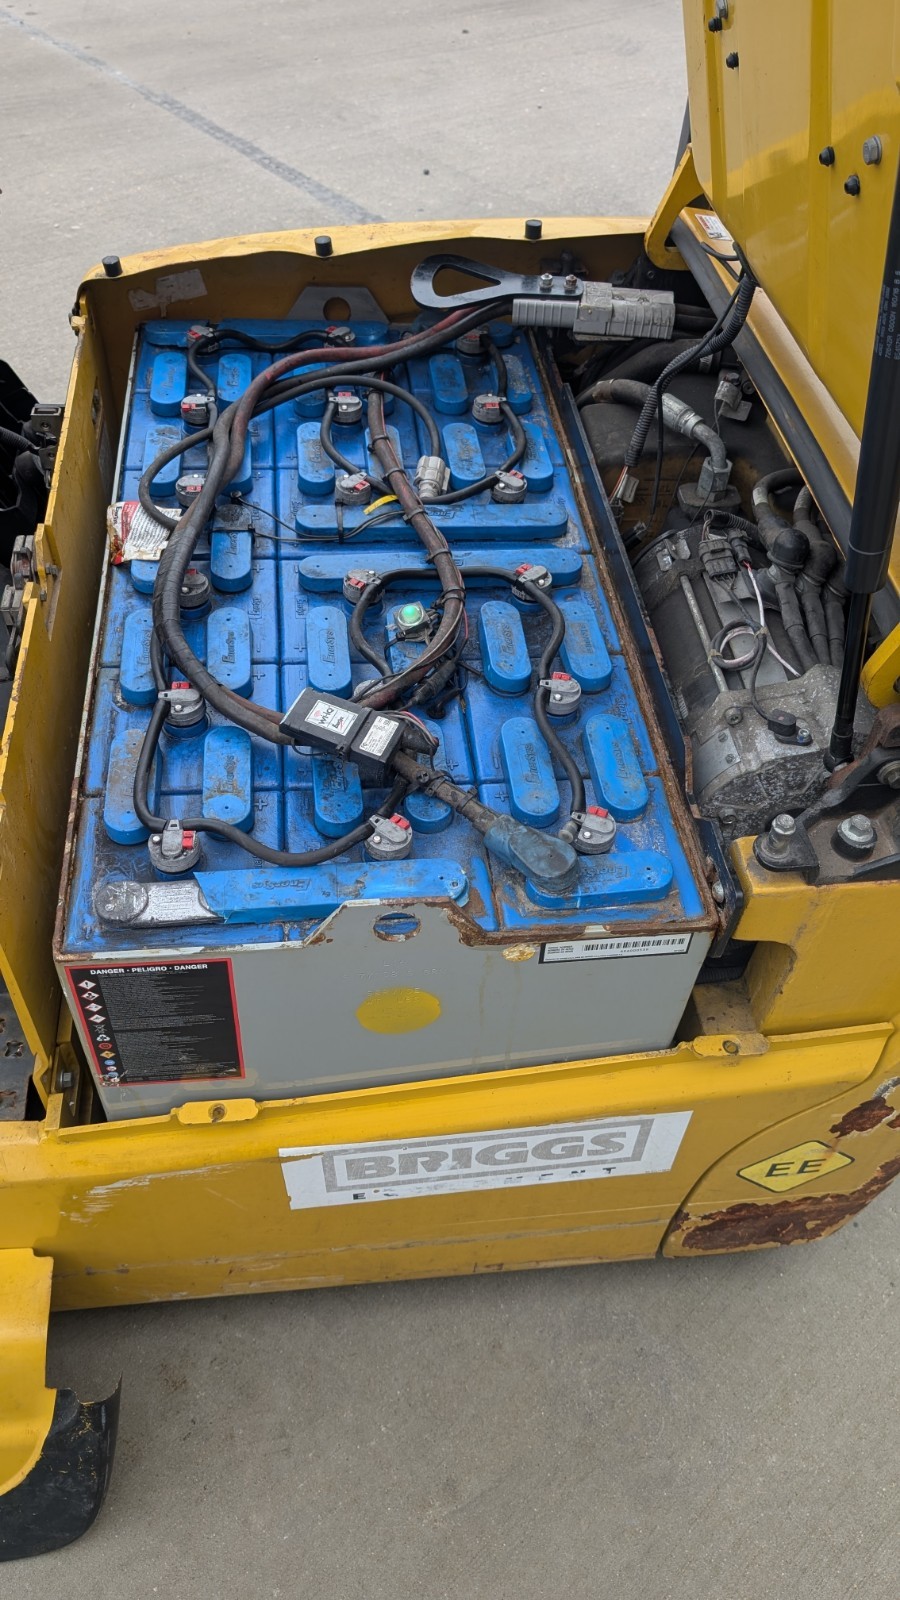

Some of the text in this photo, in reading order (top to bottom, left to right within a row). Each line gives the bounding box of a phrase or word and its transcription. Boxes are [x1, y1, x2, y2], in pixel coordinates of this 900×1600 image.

[323, 630, 335, 664] EnerSys
[524, 743, 540, 784] EnerSys
[345, 1132, 626, 1180] BRIGGS
[764, 1158, 827, 1177] EE
